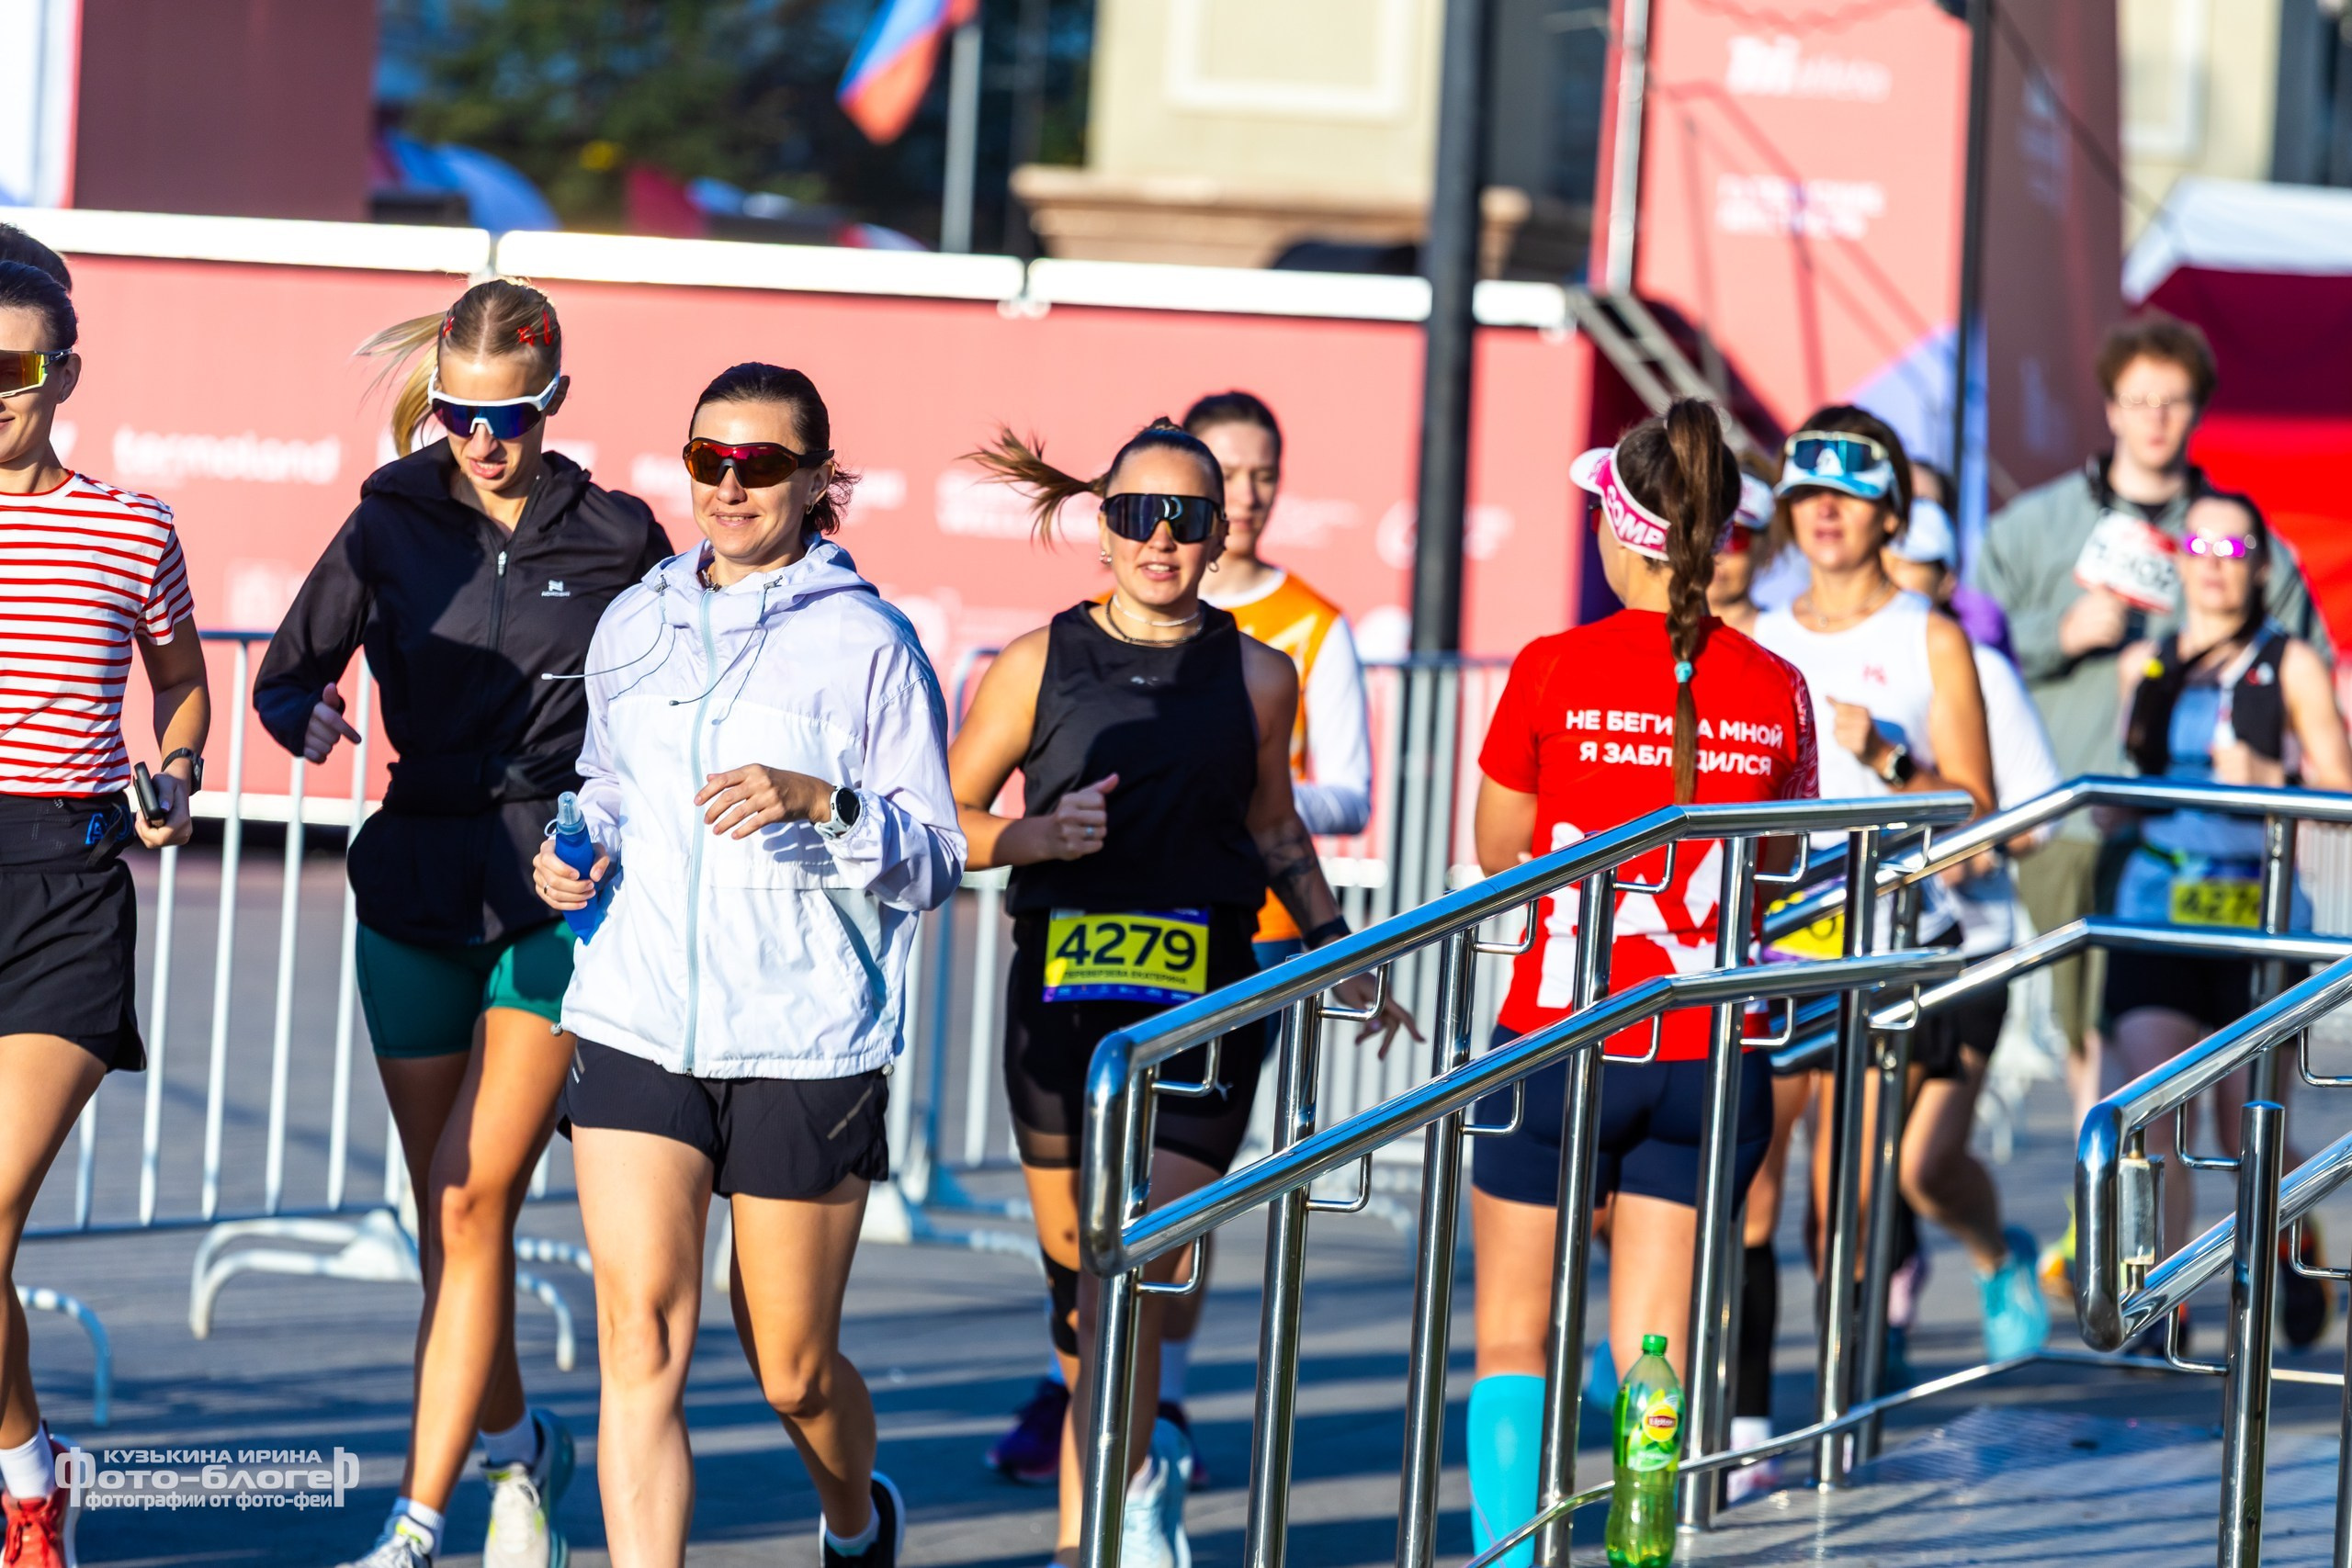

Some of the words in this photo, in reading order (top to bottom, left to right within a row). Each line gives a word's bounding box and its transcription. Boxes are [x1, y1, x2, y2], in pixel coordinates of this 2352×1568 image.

[1566, 709, 1601, 730] НЕ
[1606, 710, 1673, 736] БЕГИ
[1719, 719, 1784, 750] МНОЙ
[1579, 741, 1599, 762] Я
[1602, 742, 1772, 776] ЗАБЛДИЛСЯ
[1055, 922, 1197, 973] 4279
